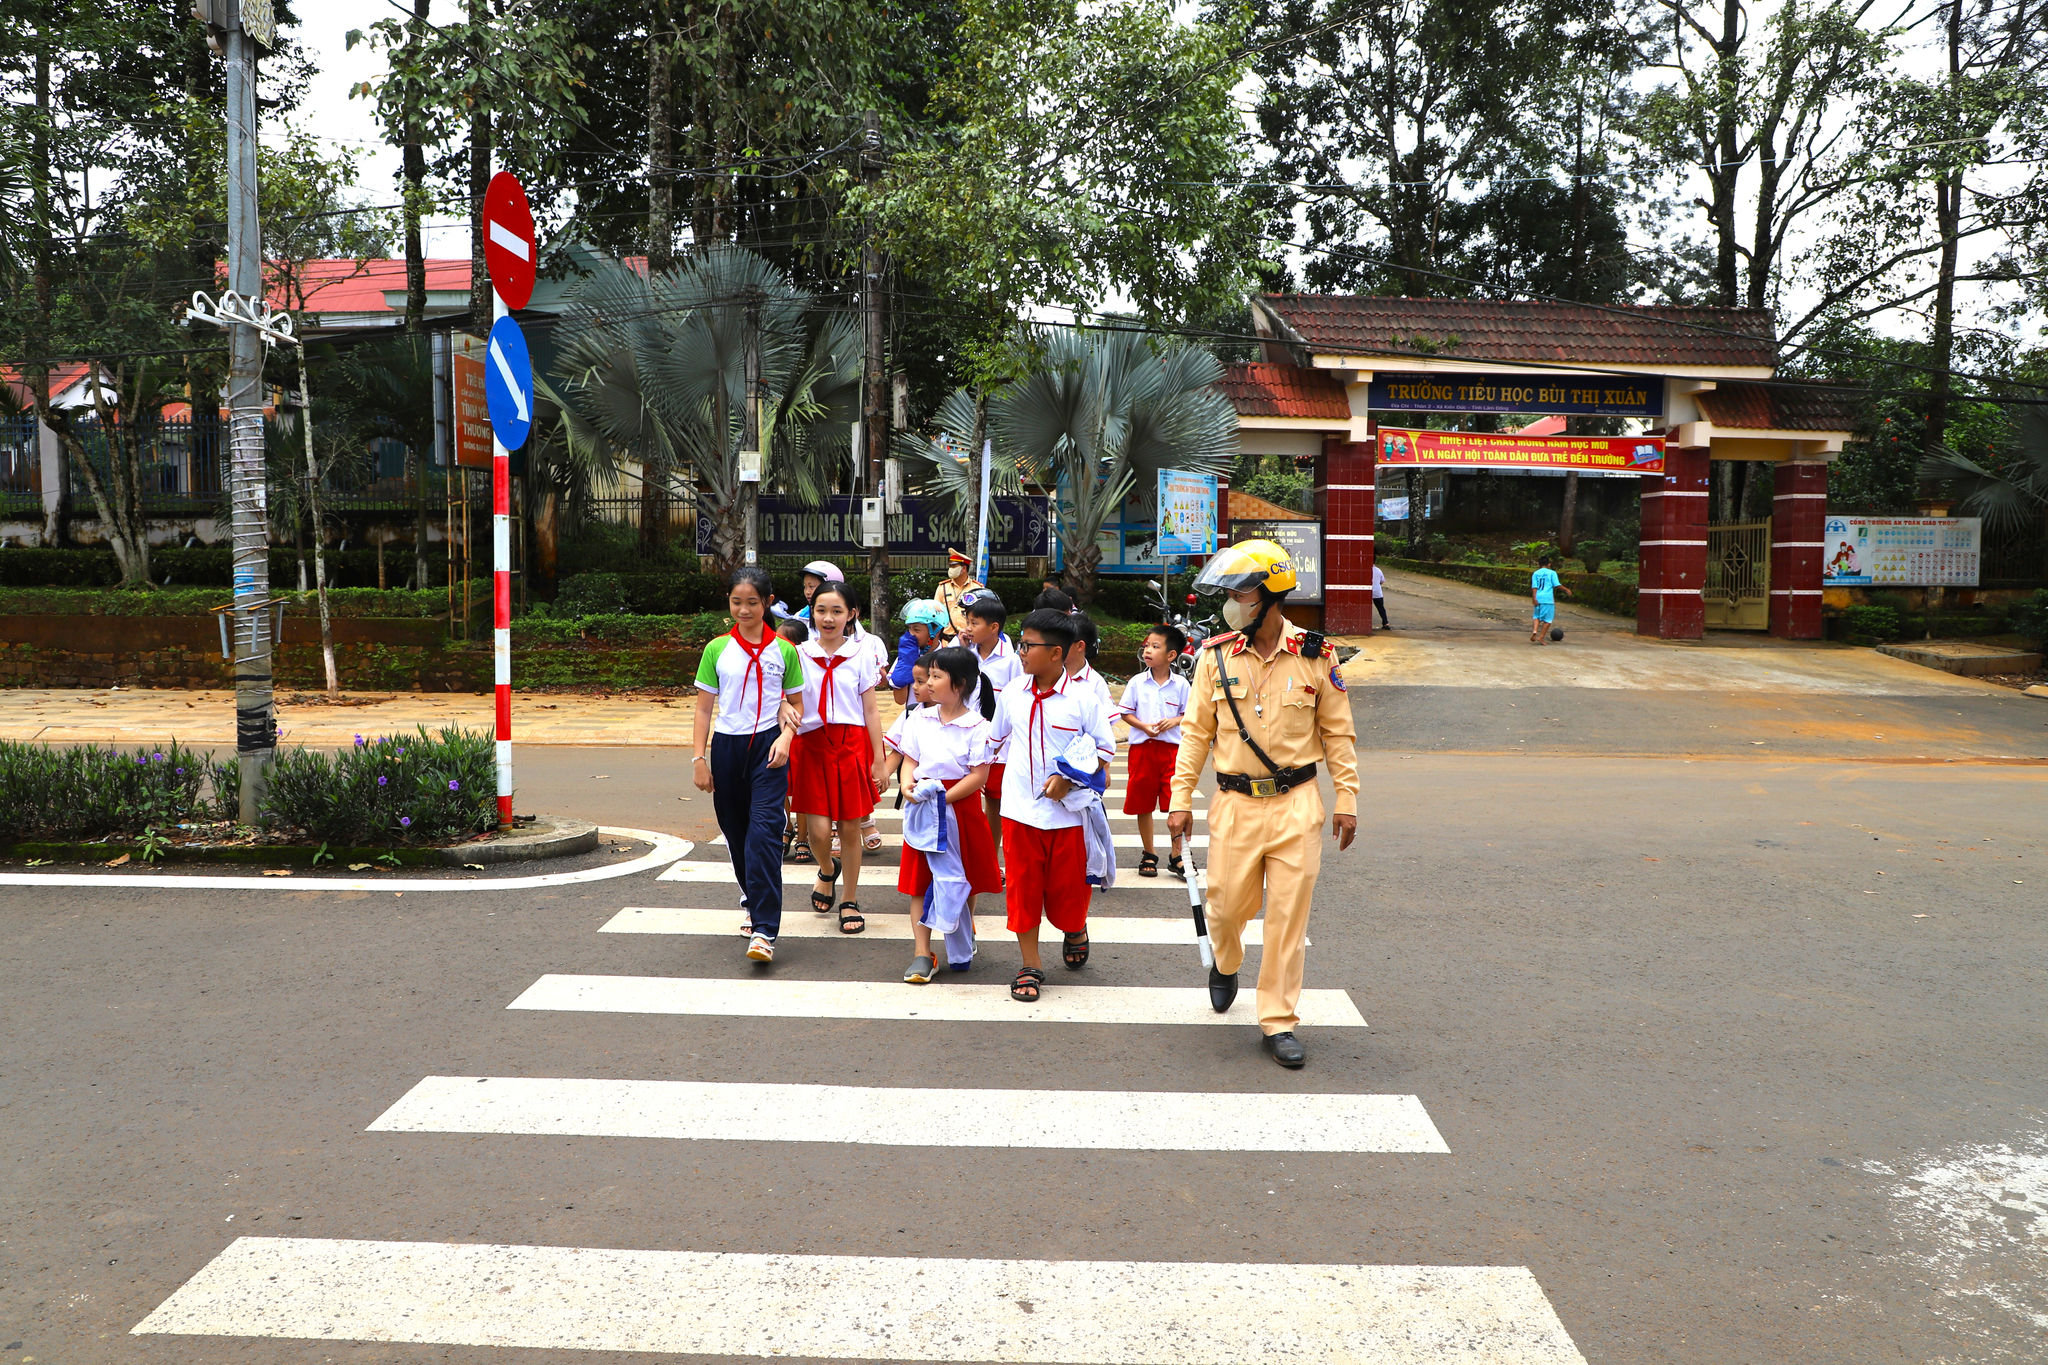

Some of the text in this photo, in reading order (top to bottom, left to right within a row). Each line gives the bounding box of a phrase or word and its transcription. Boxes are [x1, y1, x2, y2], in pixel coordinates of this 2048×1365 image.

[1387, 376, 1648, 408] TRƯỜNG TIỂU HỌC BÙI THỊ XUÂN
[461, 400, 478, 417] TÌNH
[463, 421, 491, 439] THƯƠNG
[1422, 448, 1625, 465] VÀ NGÀY HỘI TOÀN DÂN ĐƯA TRẺ ĐẾN TRƯỜNG
[778, 507, 840, 542] TRƯỜNG
